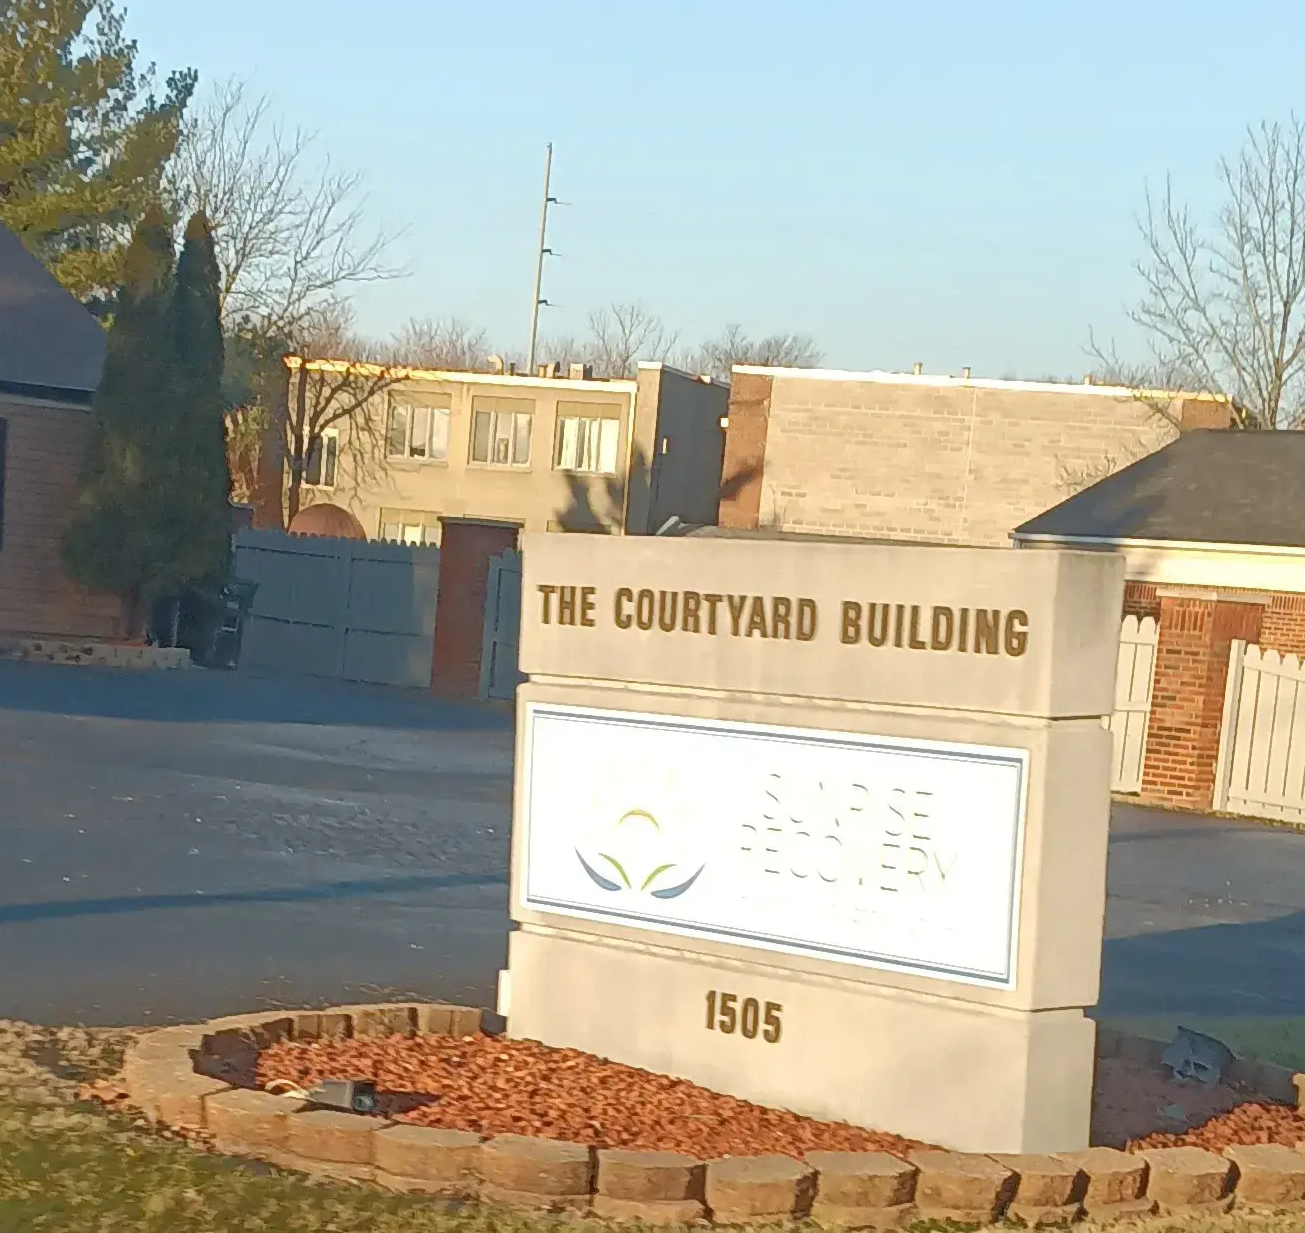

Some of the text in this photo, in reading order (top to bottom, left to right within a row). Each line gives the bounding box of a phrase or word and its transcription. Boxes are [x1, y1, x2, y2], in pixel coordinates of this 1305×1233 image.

[537, 584, 1030, 657] THE COURTYARD BUILDING
[704, 989, 784, 1044] 1505
